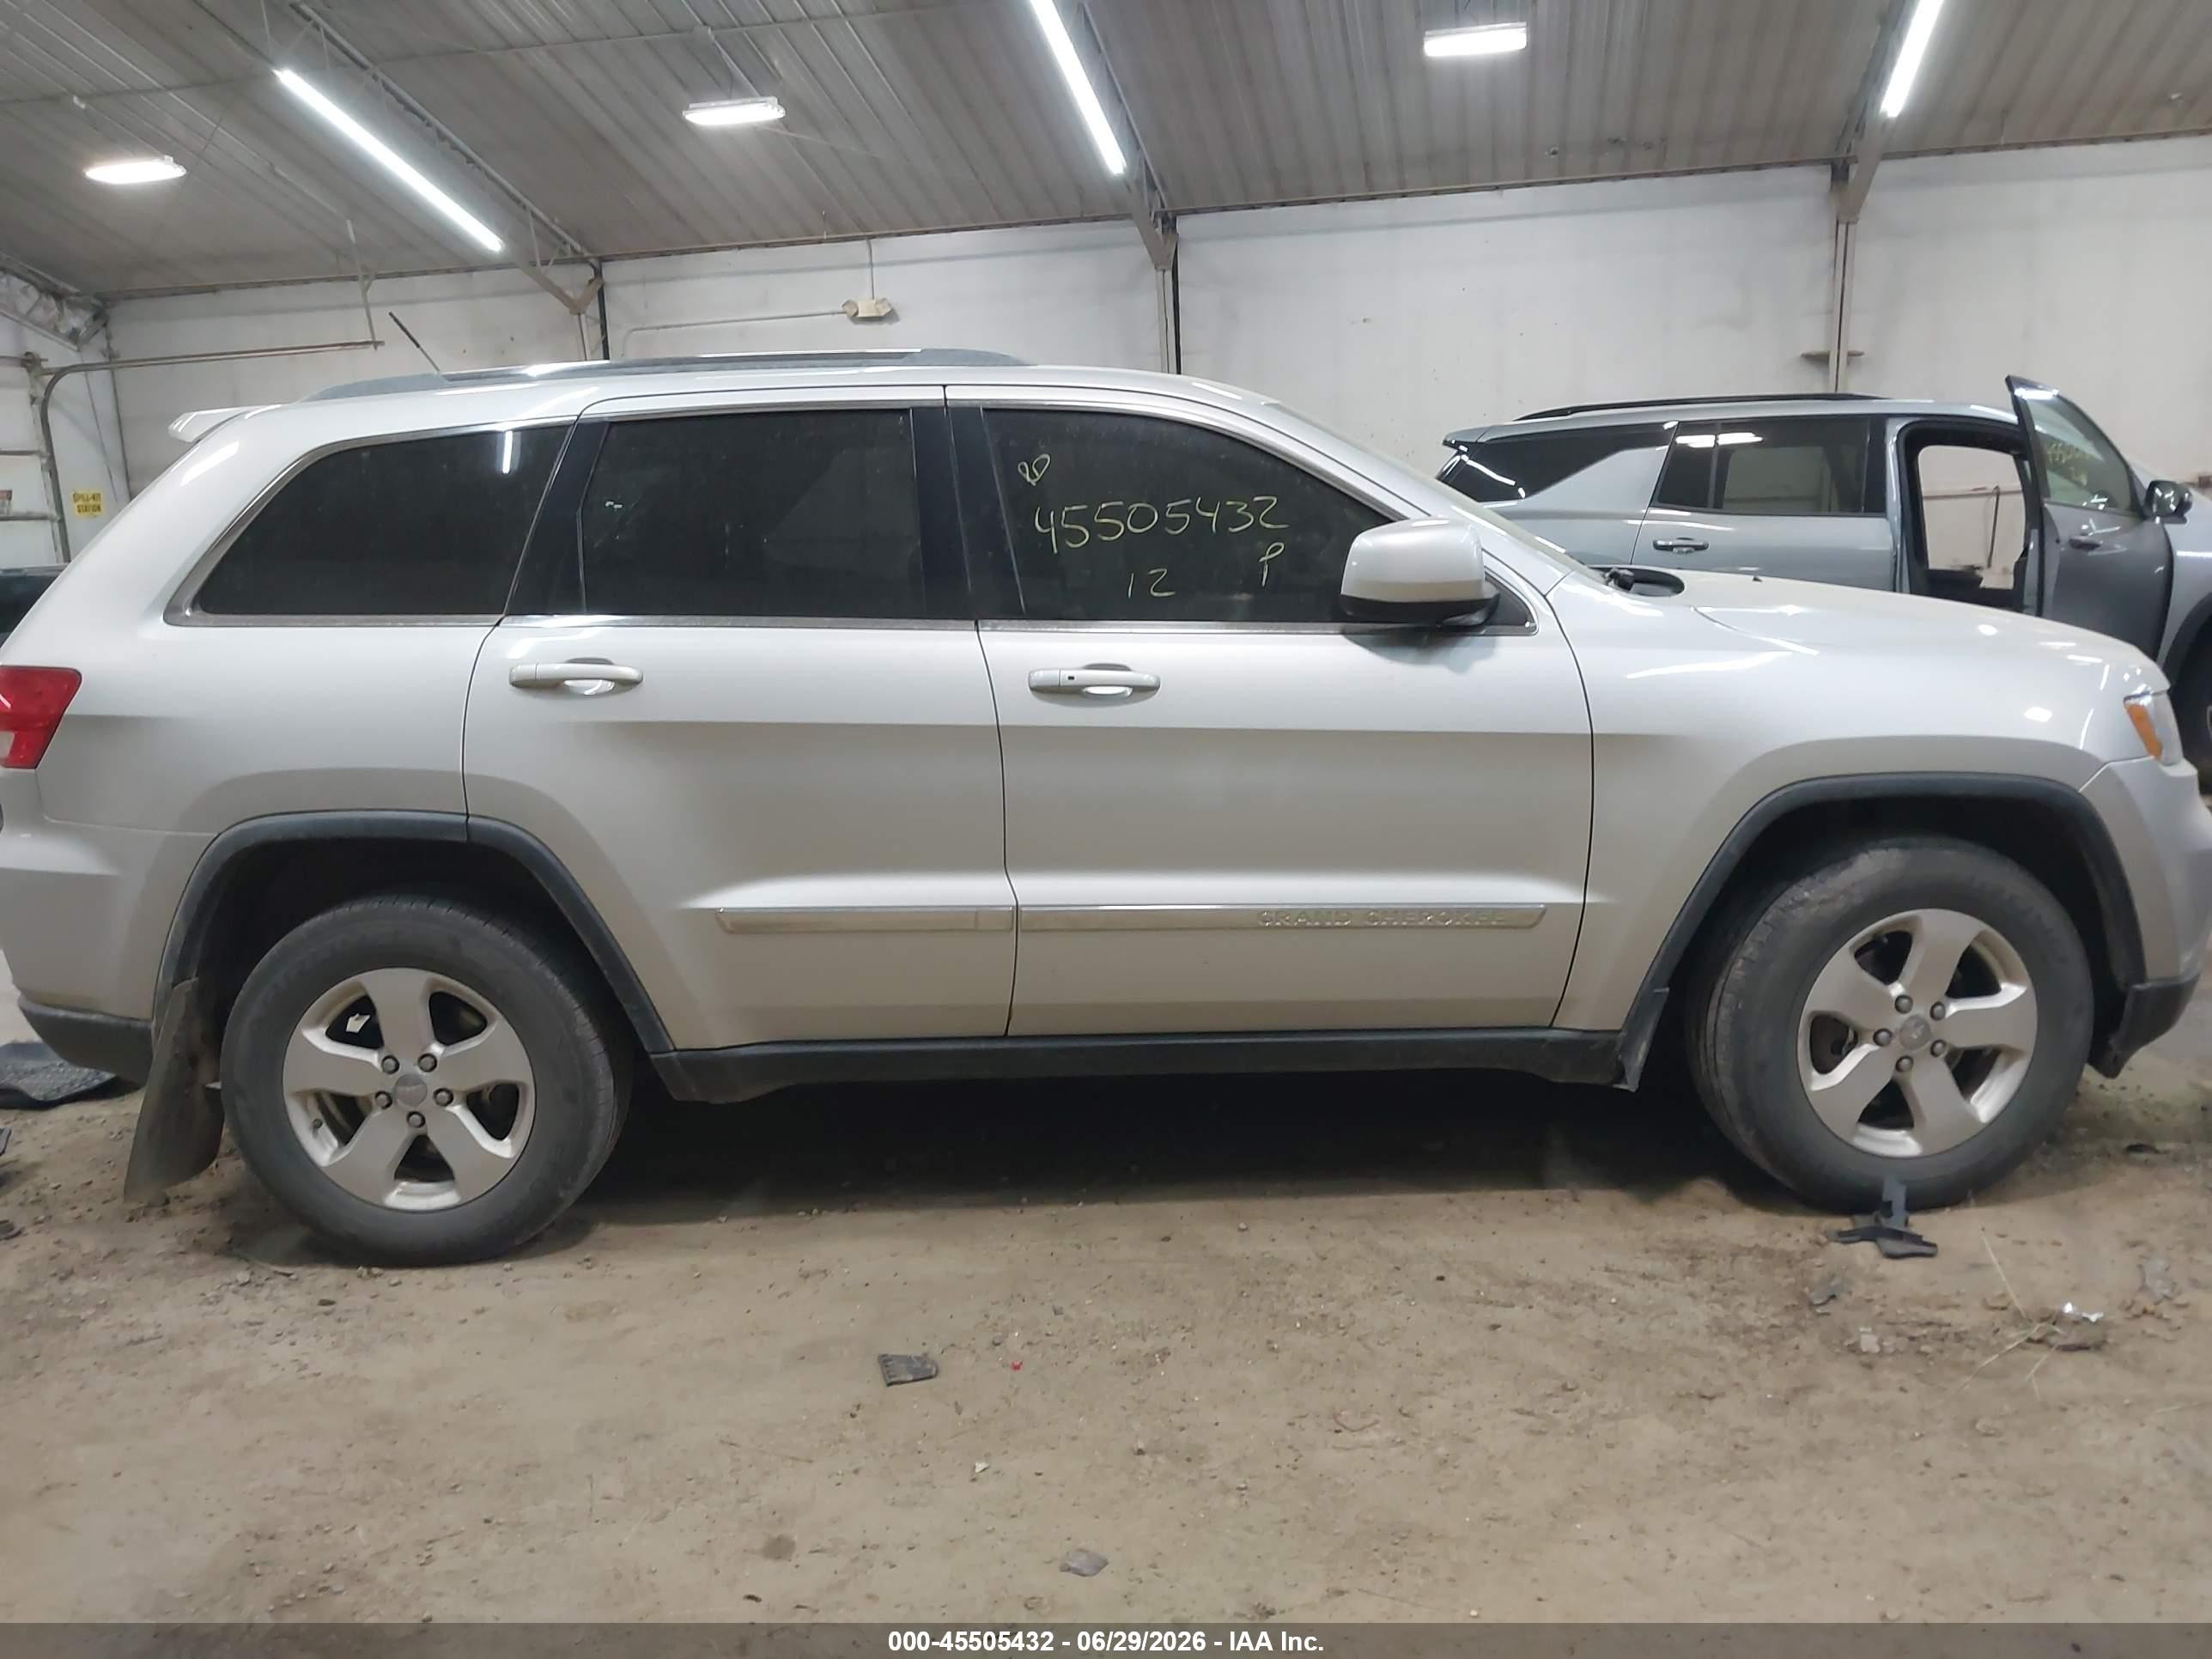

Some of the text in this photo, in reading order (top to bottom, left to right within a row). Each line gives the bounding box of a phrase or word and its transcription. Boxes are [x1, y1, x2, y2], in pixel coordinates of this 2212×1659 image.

[1034, 495, 1291, 555] 45505432
[1127, 568, 1176, 599] 12
[1257, 909, 1507, 927] GRAND CHEROKEE
